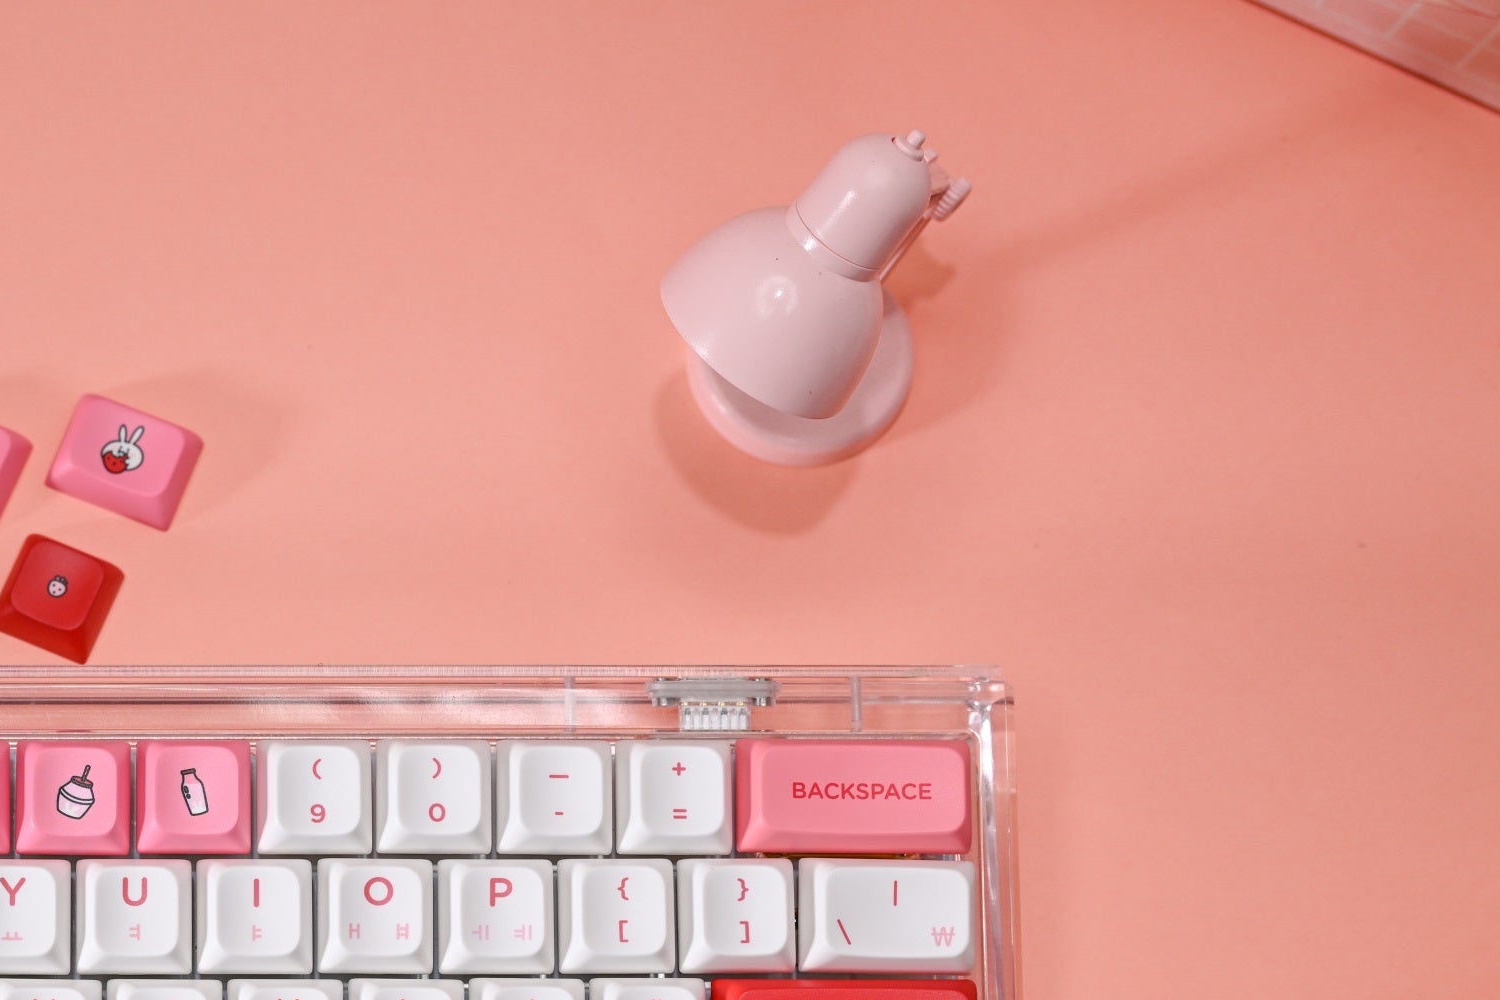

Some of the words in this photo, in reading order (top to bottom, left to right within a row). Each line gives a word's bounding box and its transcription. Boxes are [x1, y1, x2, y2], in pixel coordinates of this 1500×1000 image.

[792, 781, 932, 801] BACKSPACE
[309, 803, 327, 824] 9
[428, 802, 446, 823] 0
[0, 876, 27, 907] Y
[121, 876, 148, 907] U
[363, 876, 394, 907] O
[489, 877, 513, 908] P
